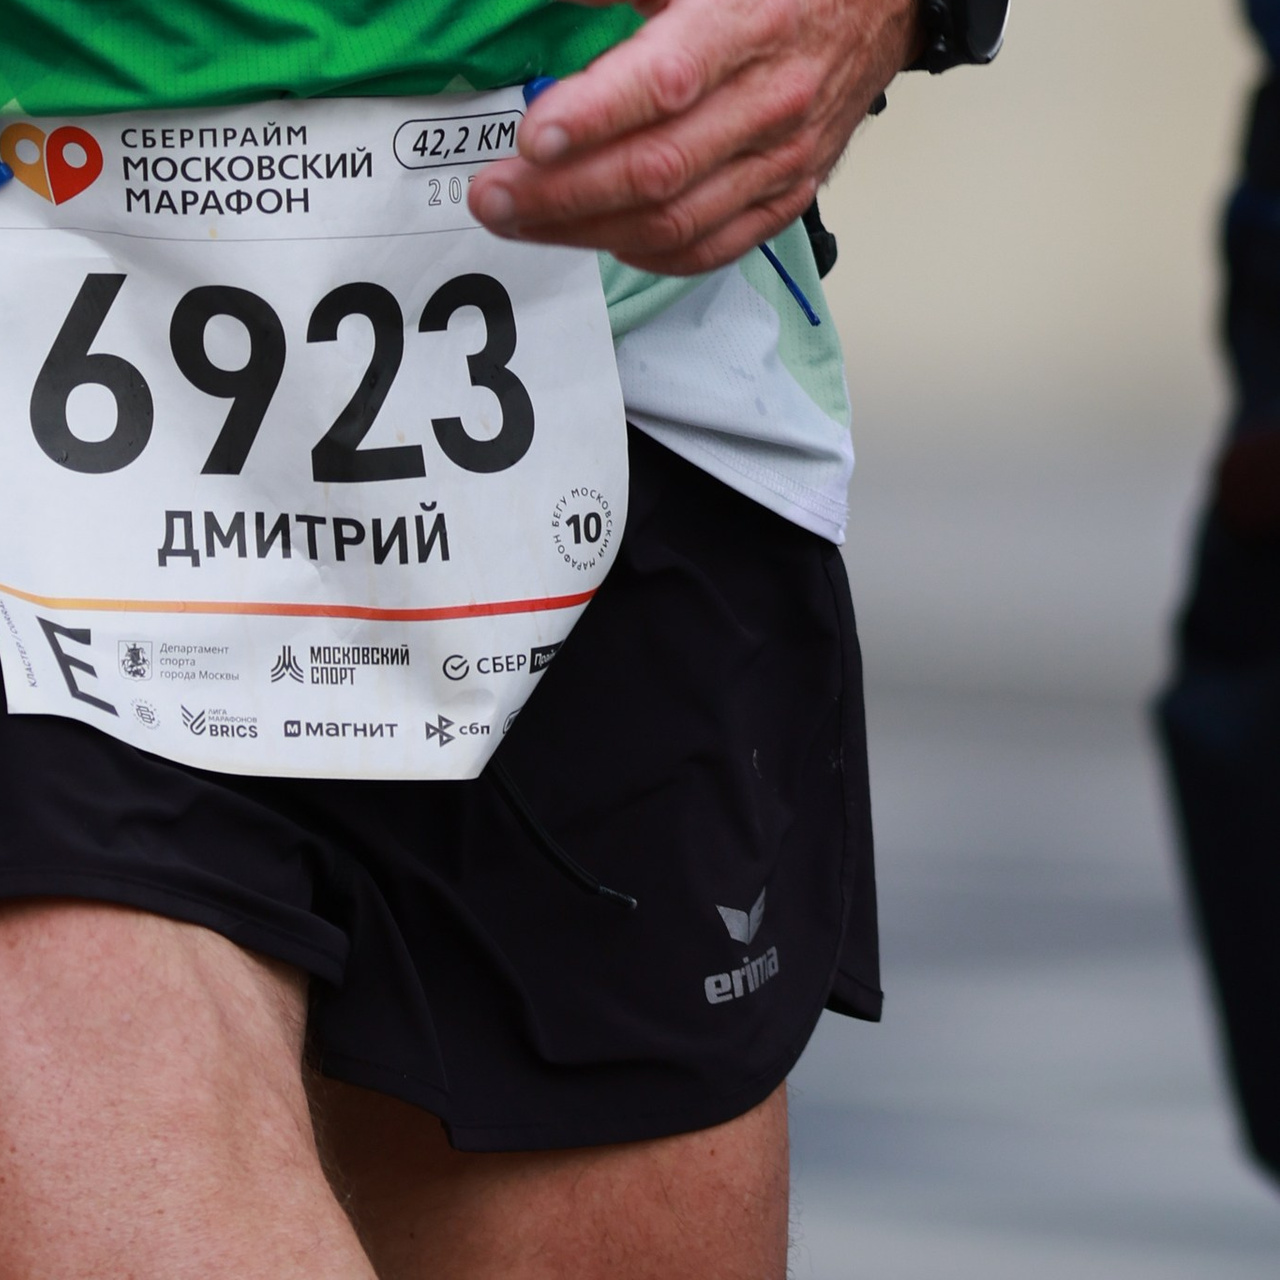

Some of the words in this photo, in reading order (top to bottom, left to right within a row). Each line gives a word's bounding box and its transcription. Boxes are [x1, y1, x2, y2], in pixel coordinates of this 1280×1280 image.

[121, 121, 308, 149] СБЕРПРАЙМ
[412, 126, 470, 159] 42,2
[122, 146, 373, 182] МОСКОВСКИЙ
[125, 187, 310, 215] МАРАФОН
[29, 271, 536, 483] 6923
[551, 495, 567, 528] БЕГУ
[571, 487, 613, 558] МОСКОВСКИЙ
[157, 500, 451, 568] ДМИТРИЙ
[565, 511, 602, 545] 10
[553, 534, 596, 571] МАРАФОН
[159, 643, 229, 656] Департамент
[160, 657, 196, 668] спорта
[310, 644, 410, 666] МОСКОВСКИЙ
[16, 641, 38, 688] КЛАСТЕР
[160, 670, 196, 681] города
[198, 670, 240, 681] Москвы
[311, 666, 356, 685] СПОРТ
[476, 654, 527, 674] СБЕР
[208, 708, 227, 716] ЛИГА
[208, 716, 258, 724] МАРАФОНОВ
[209, 724, 258, 739] BRICS
[305, 722, 398, 738] магнит
[459, 722, 491, 736] сбп
[704, 945, 780, 1005] erima
